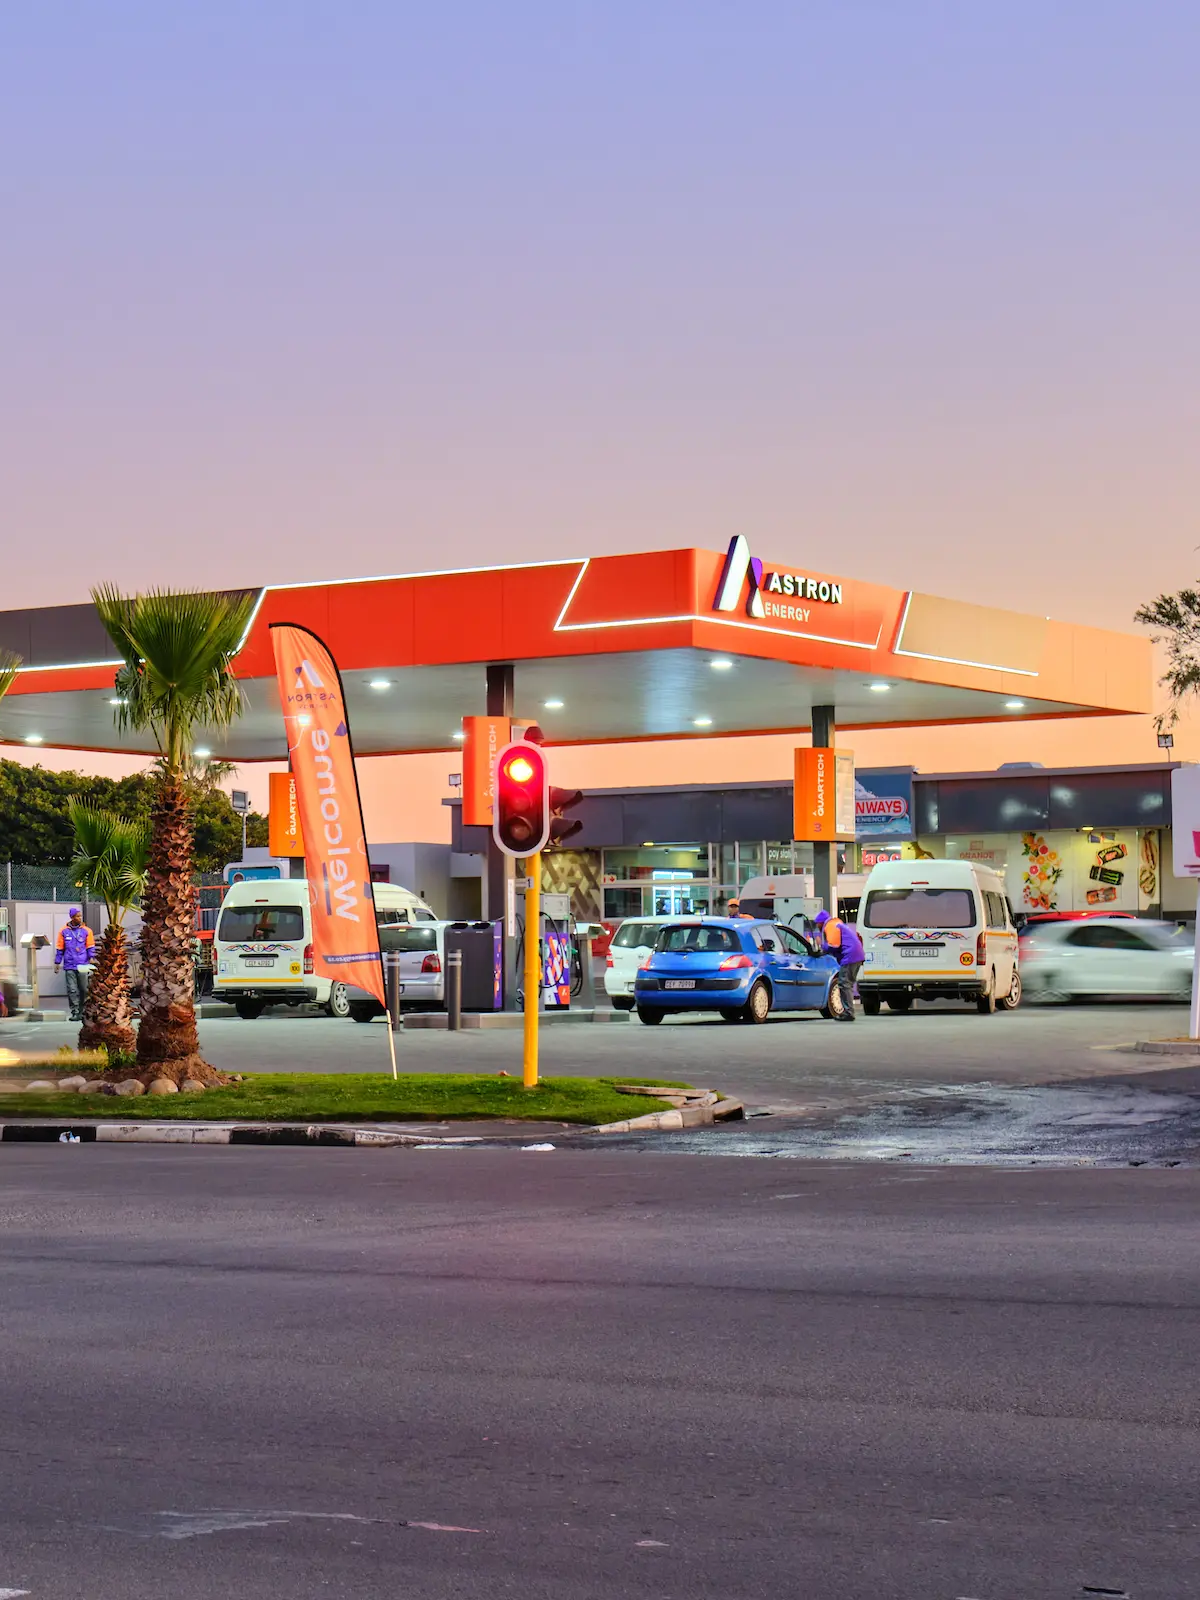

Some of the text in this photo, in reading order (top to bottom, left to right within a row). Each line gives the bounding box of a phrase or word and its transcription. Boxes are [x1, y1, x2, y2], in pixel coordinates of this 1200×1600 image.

[768, 571, 843, 604] ASTRON
[764, 602, 810, 622] ENERGY
[289, 779, 297, 836] QUARTECH
[855, 800, 902, 814] NWAYS
[813, 823, 822, 832] 3
